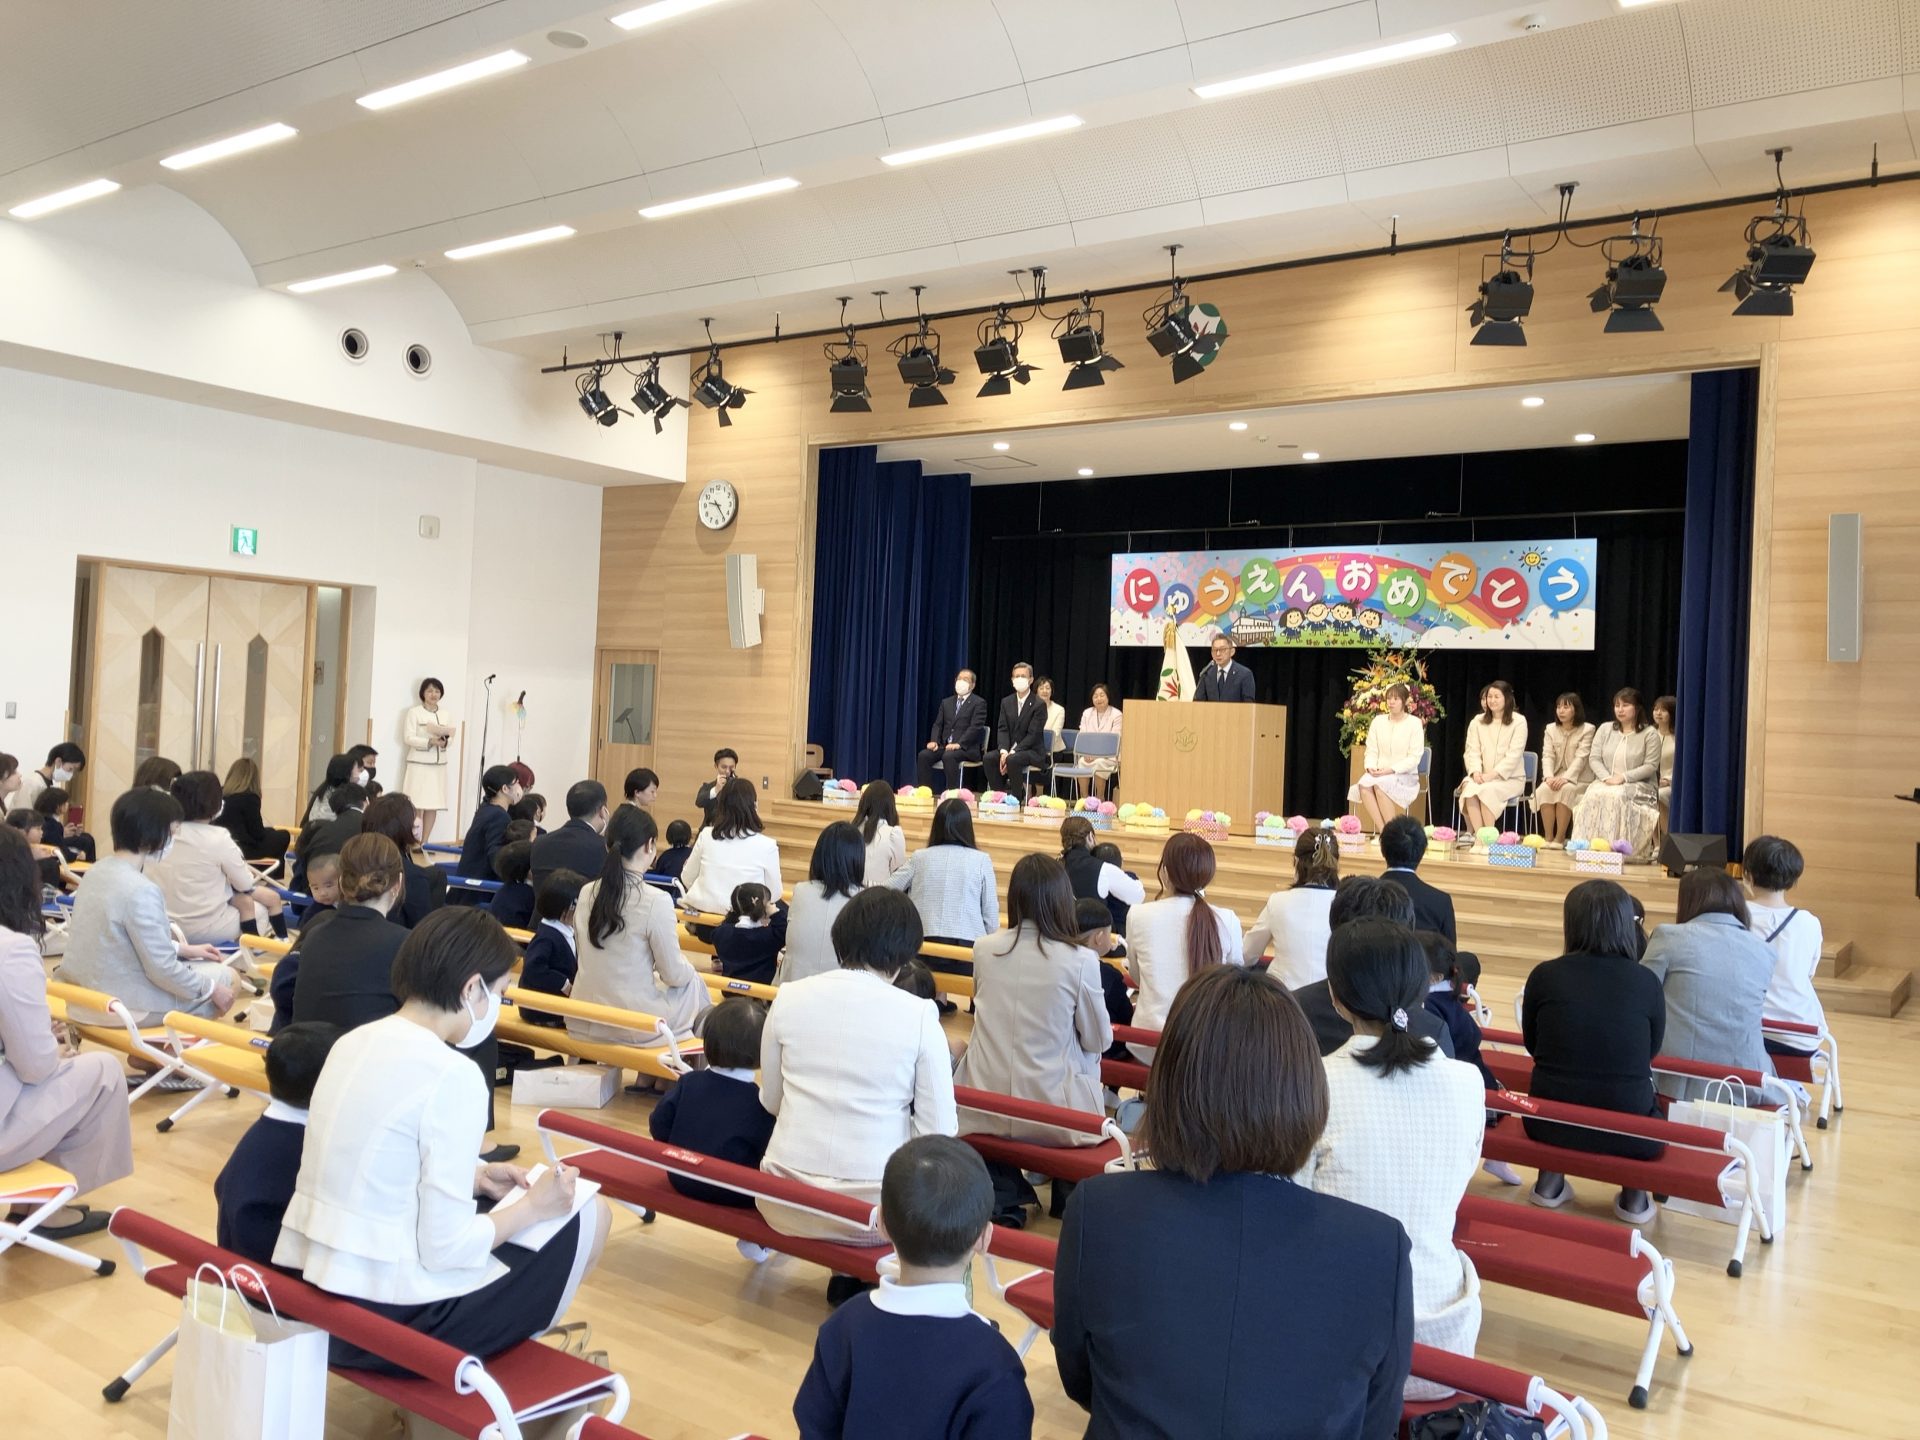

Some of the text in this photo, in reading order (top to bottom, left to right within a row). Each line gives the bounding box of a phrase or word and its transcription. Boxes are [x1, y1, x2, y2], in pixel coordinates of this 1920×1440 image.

[1129, 559, 1581, 614] にゅうえんおめでとう
